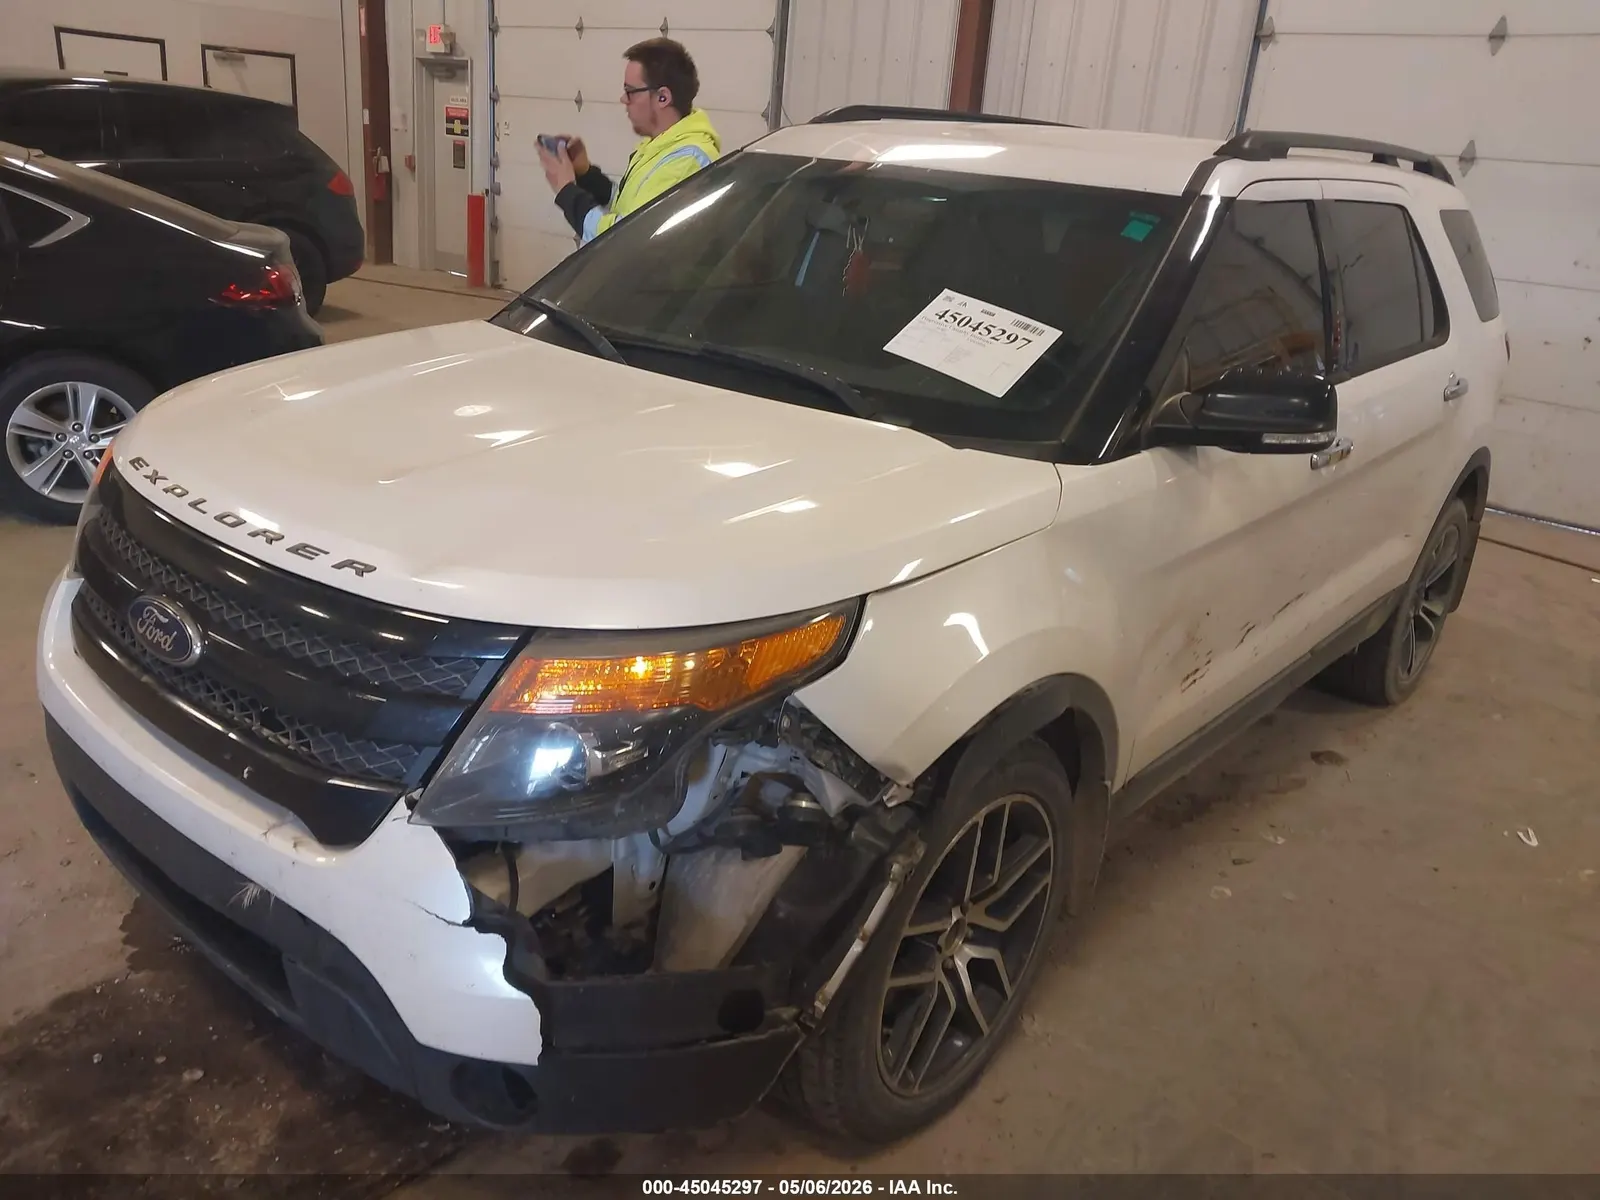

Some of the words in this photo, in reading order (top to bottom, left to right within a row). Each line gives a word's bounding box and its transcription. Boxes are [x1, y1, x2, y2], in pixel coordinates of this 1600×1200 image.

[934, 308, 1034, 351] 45045297
[128, 456, 377, 578] EXPLORER
[137, 605, 178, 652] Ford
